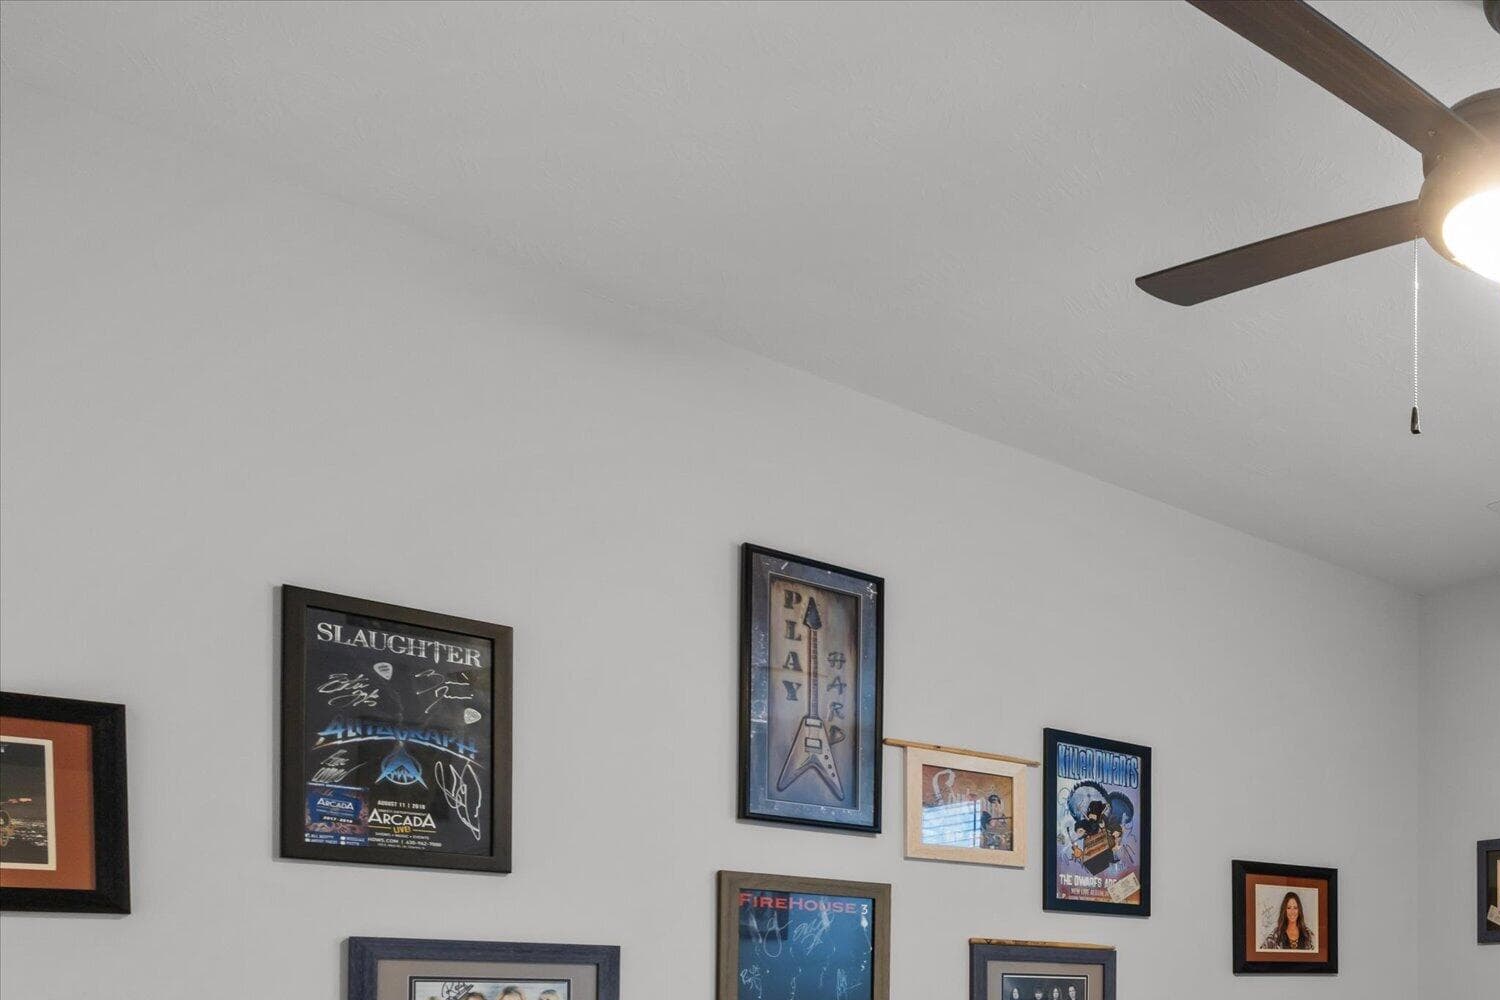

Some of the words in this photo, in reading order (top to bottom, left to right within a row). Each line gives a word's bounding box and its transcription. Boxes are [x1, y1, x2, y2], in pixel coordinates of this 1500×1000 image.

[316, 622, 483, 668] SLAUGHTER
[783, 589, 802, 700] PLAY
[317, 797, 354, 811] ARCADA
[367, 808, 437, 829] ARCADA
[1059, 873, 1073, 885] THE
[738, 892, 857, 914] FIREHOUSE
[860, 904, 868, 915] 3
